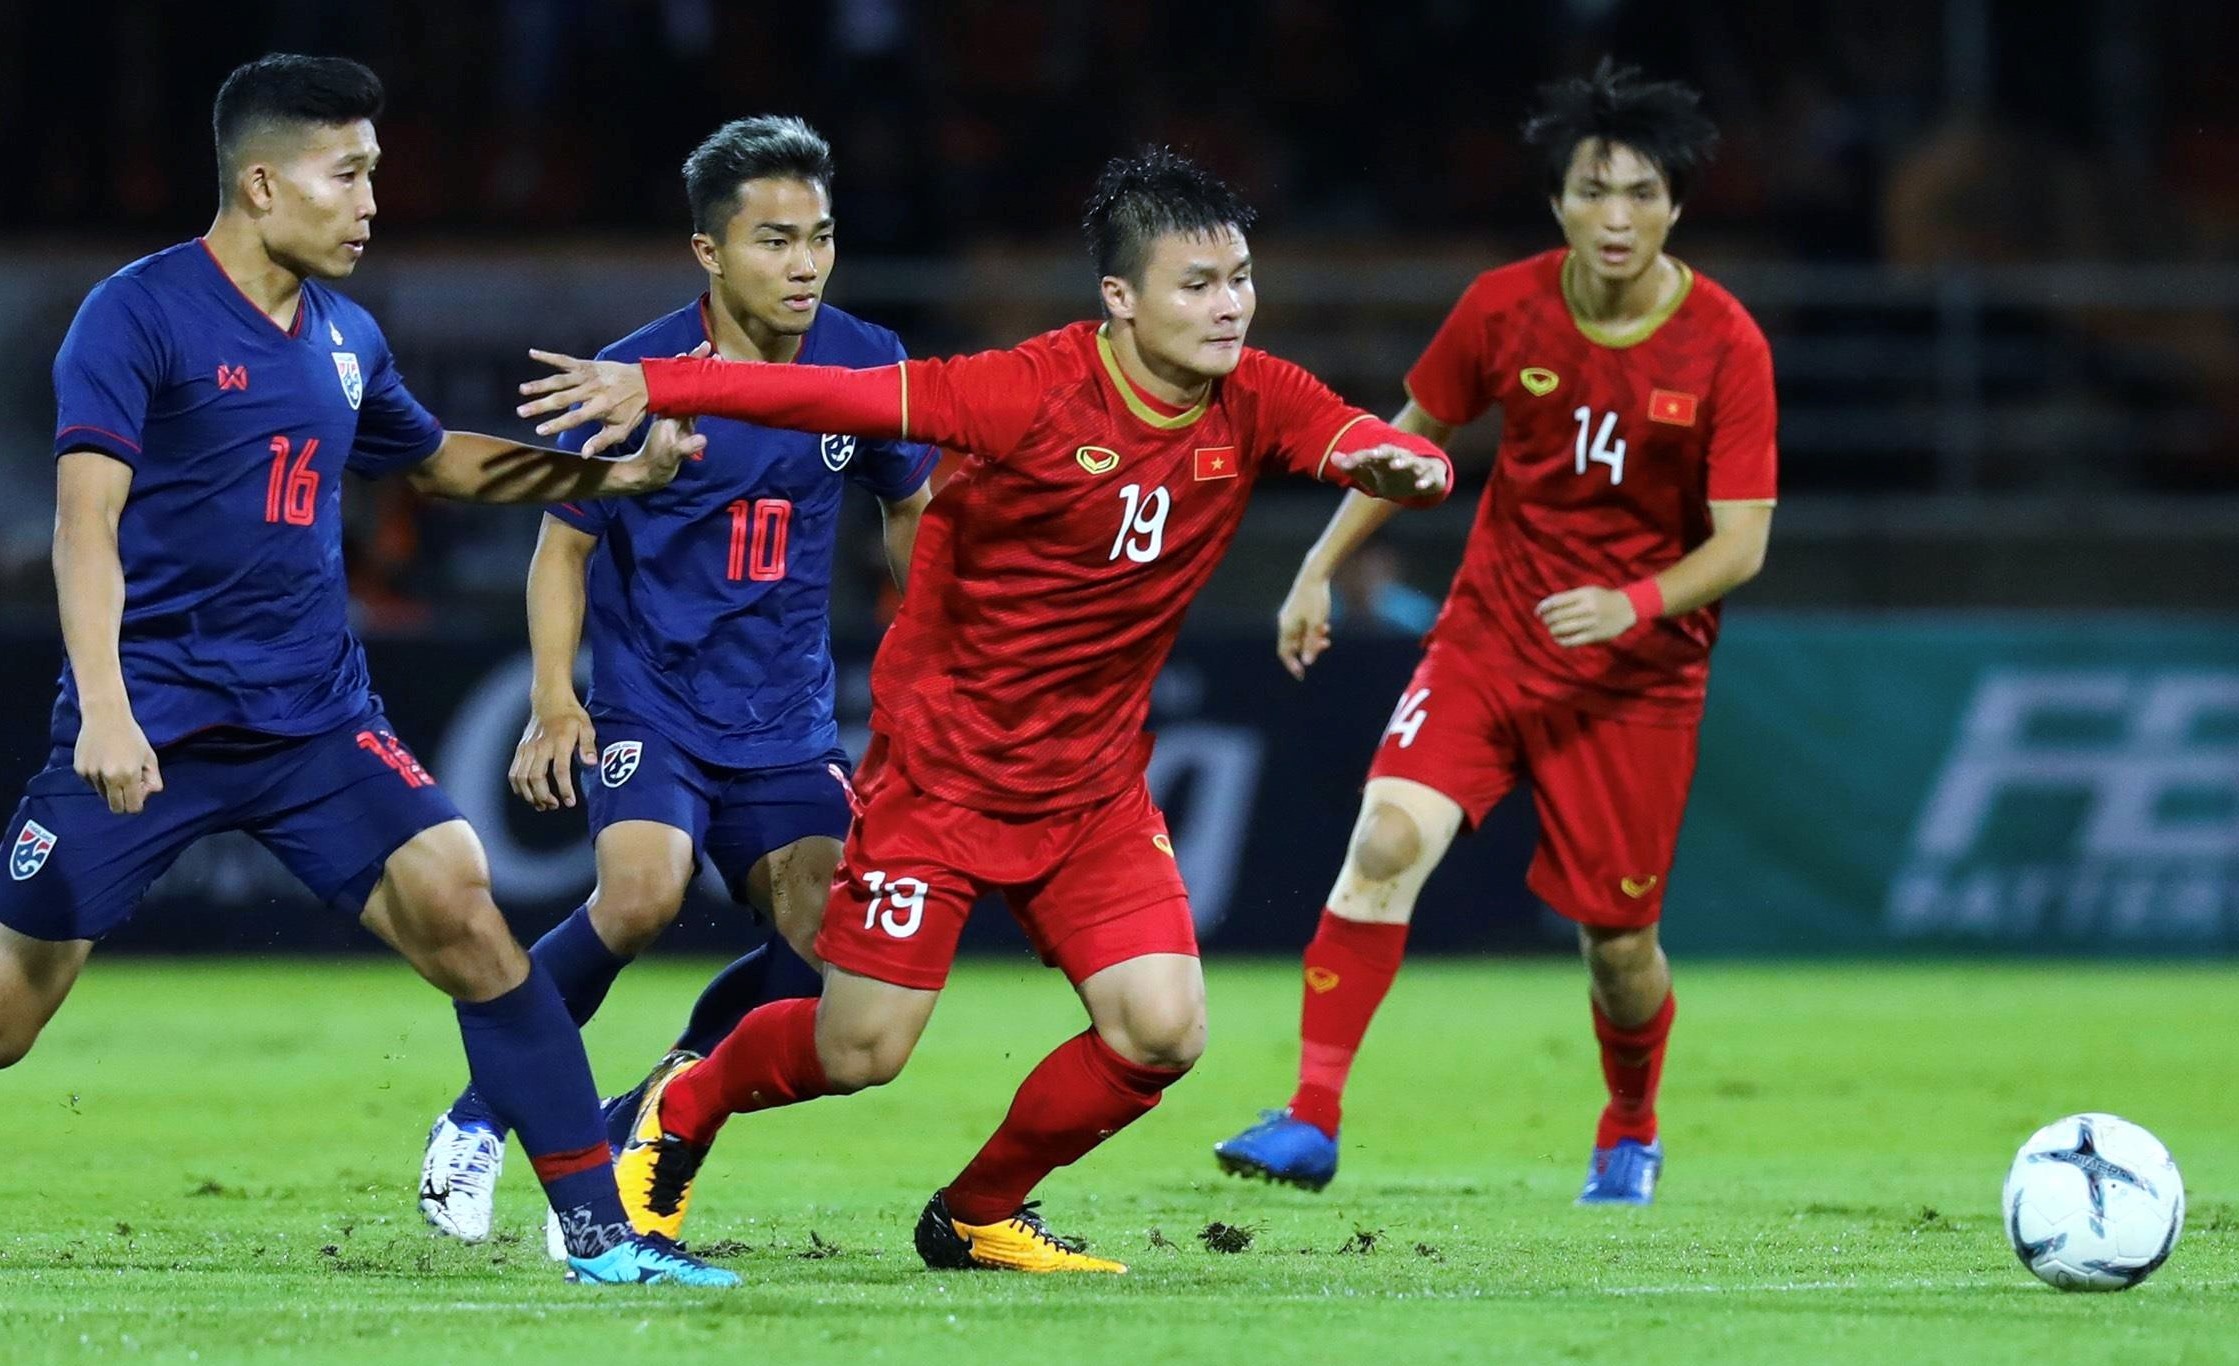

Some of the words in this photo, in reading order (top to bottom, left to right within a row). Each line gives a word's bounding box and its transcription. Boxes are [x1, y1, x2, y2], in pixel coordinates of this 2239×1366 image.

[265, 435, 320, 526] 16
[1574, 406, 1626, 485] 14
[727, 498, 792, 582] 10
[1109, 483, 1170, 563] 19
[862, 870, 929, 939] 19
